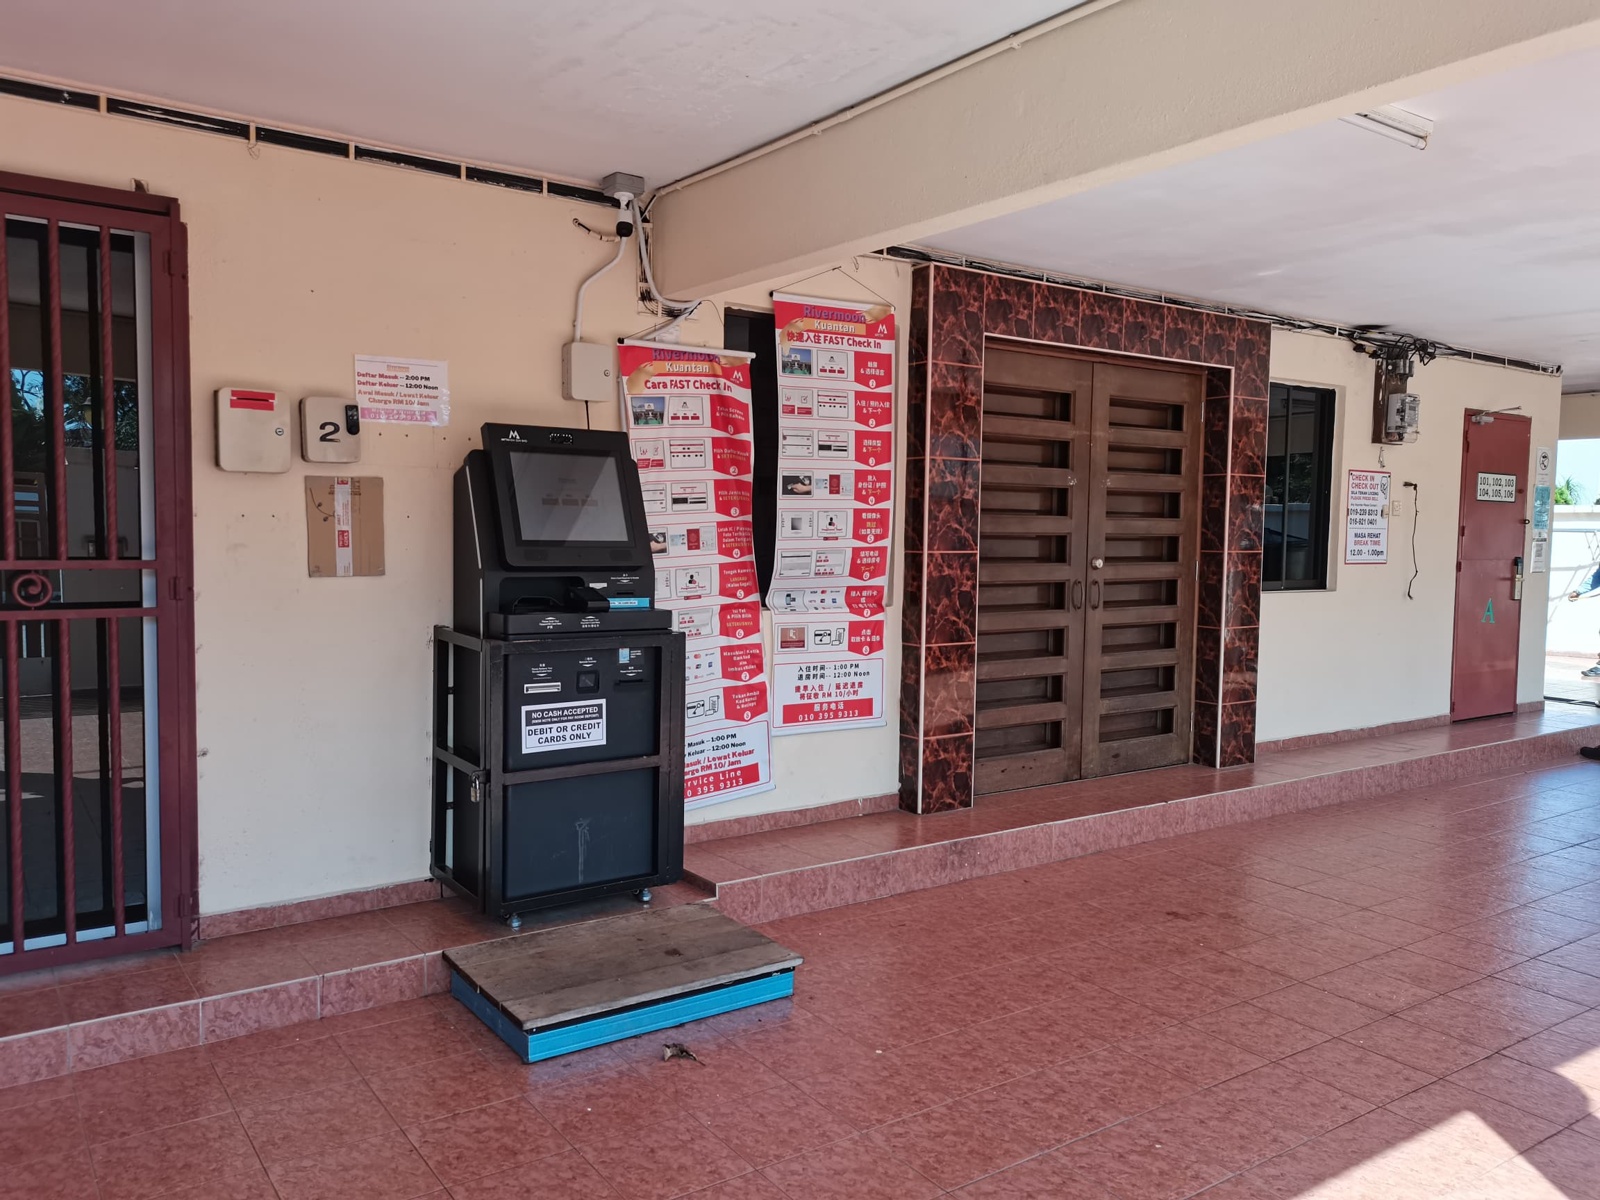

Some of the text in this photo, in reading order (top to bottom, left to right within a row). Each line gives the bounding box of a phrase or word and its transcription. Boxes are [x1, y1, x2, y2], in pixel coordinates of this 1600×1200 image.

[803, 305, 866, 324] Rivermoon
[814, 319, 856, 333] Kuantan
[786, 330, 882, 350] 快速入住 FAST Check In
[666, 362, 710, 373] Kuantan
[644, 380, 668, 390] Cara
[670, 380, 690, 390] FAST
[692, 380, 721, 391] Check
[723, 382, 732, 393] In
[319, 422, 340, 442] 2
[1479, 476, 1514, 488] 101, 102, 103
[1479, 488, 1513, 500] 104, 105, 106
[1481, 598, 1495, 624] A
[835, 689, 859, 698] 10/小时
[531, 706, 598, 719] NO CASH ACCEPTED
[814, 702, 844, 712] 服务电话
[798, 710, 859, 722] 010 395 9313
[527, 722, 602, 737] DEBIT OR CREDIT
[538, 732, 592, 745] CARDS ONLY
[687, 739, 705, 748] Masuk
[710, 734, 725, 742] 1:00
[688, 748, 705, 757] Keluar
[712, 743, 730, 752] 12:00
[685, 759, 702, 768] asuk
[707, 753, 731, 763] Lewat
[732, 749, 755, 758] Keluar
[700, 764, 712, 772] RM
[714, 761, 726, 769] 10/
[720, 770, 742, 780] Line
[697, 778, 743, 795] 395 9313
